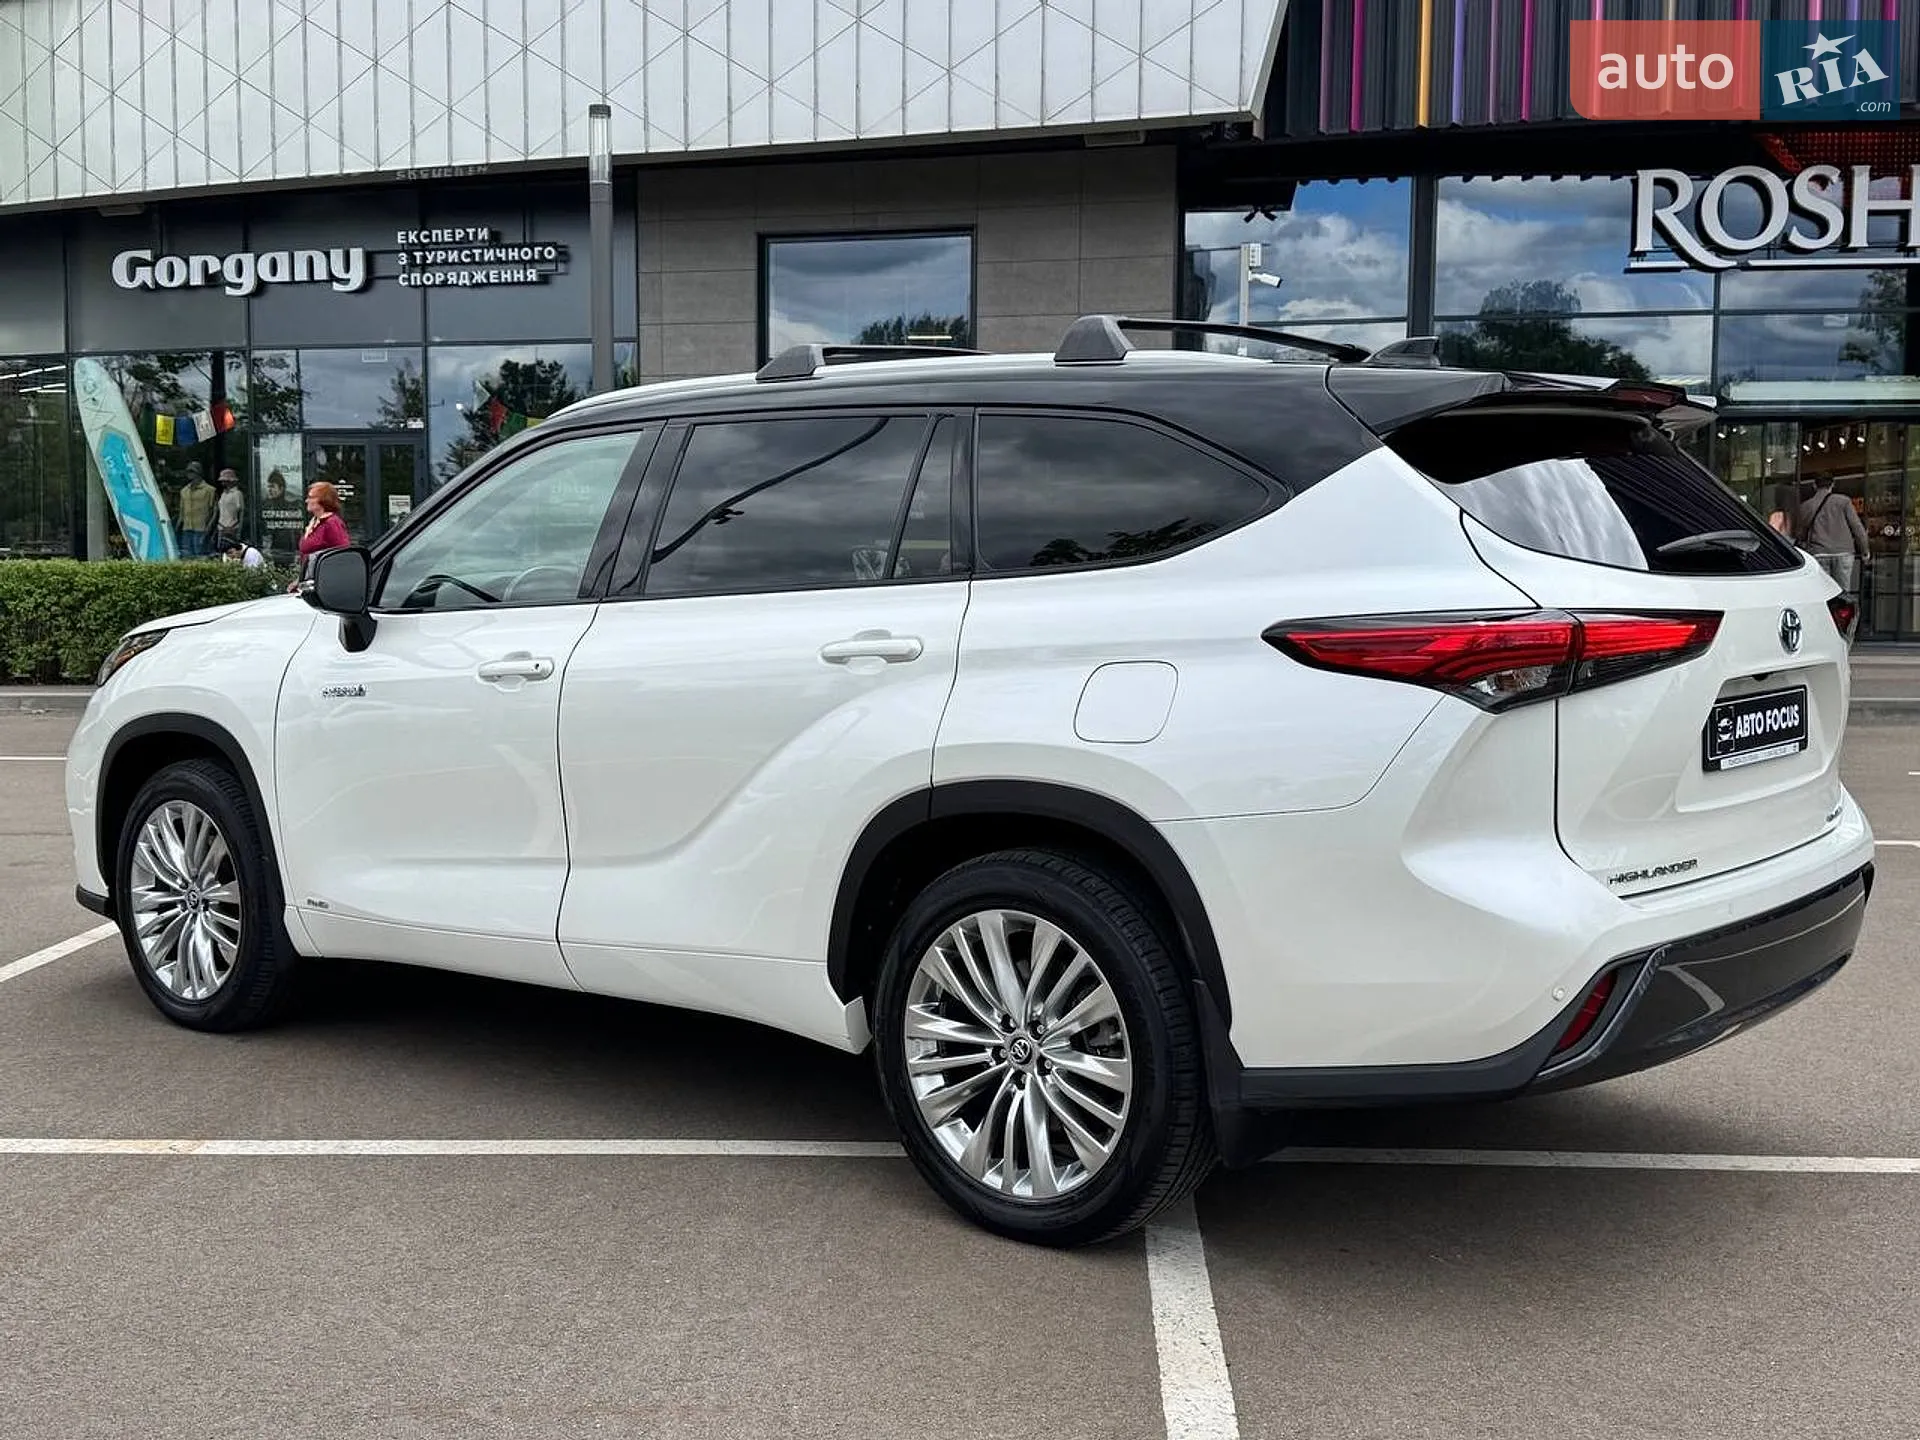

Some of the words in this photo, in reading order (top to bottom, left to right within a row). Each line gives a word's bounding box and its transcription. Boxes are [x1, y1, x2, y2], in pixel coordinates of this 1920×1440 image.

[397, 227, 490, 245] ЕКСПЕРТИ
[412, 246, 557, 265] ТУРИСТИЧНОГО
[111, 247, 364, 297] Gorgany
[398, 268, 538, 287] СПОРЯДЖЕННЯ
[1765, 704, 1800, 732] FOCUS
[1608, 858, 1698, 885] HIGHLANDER
